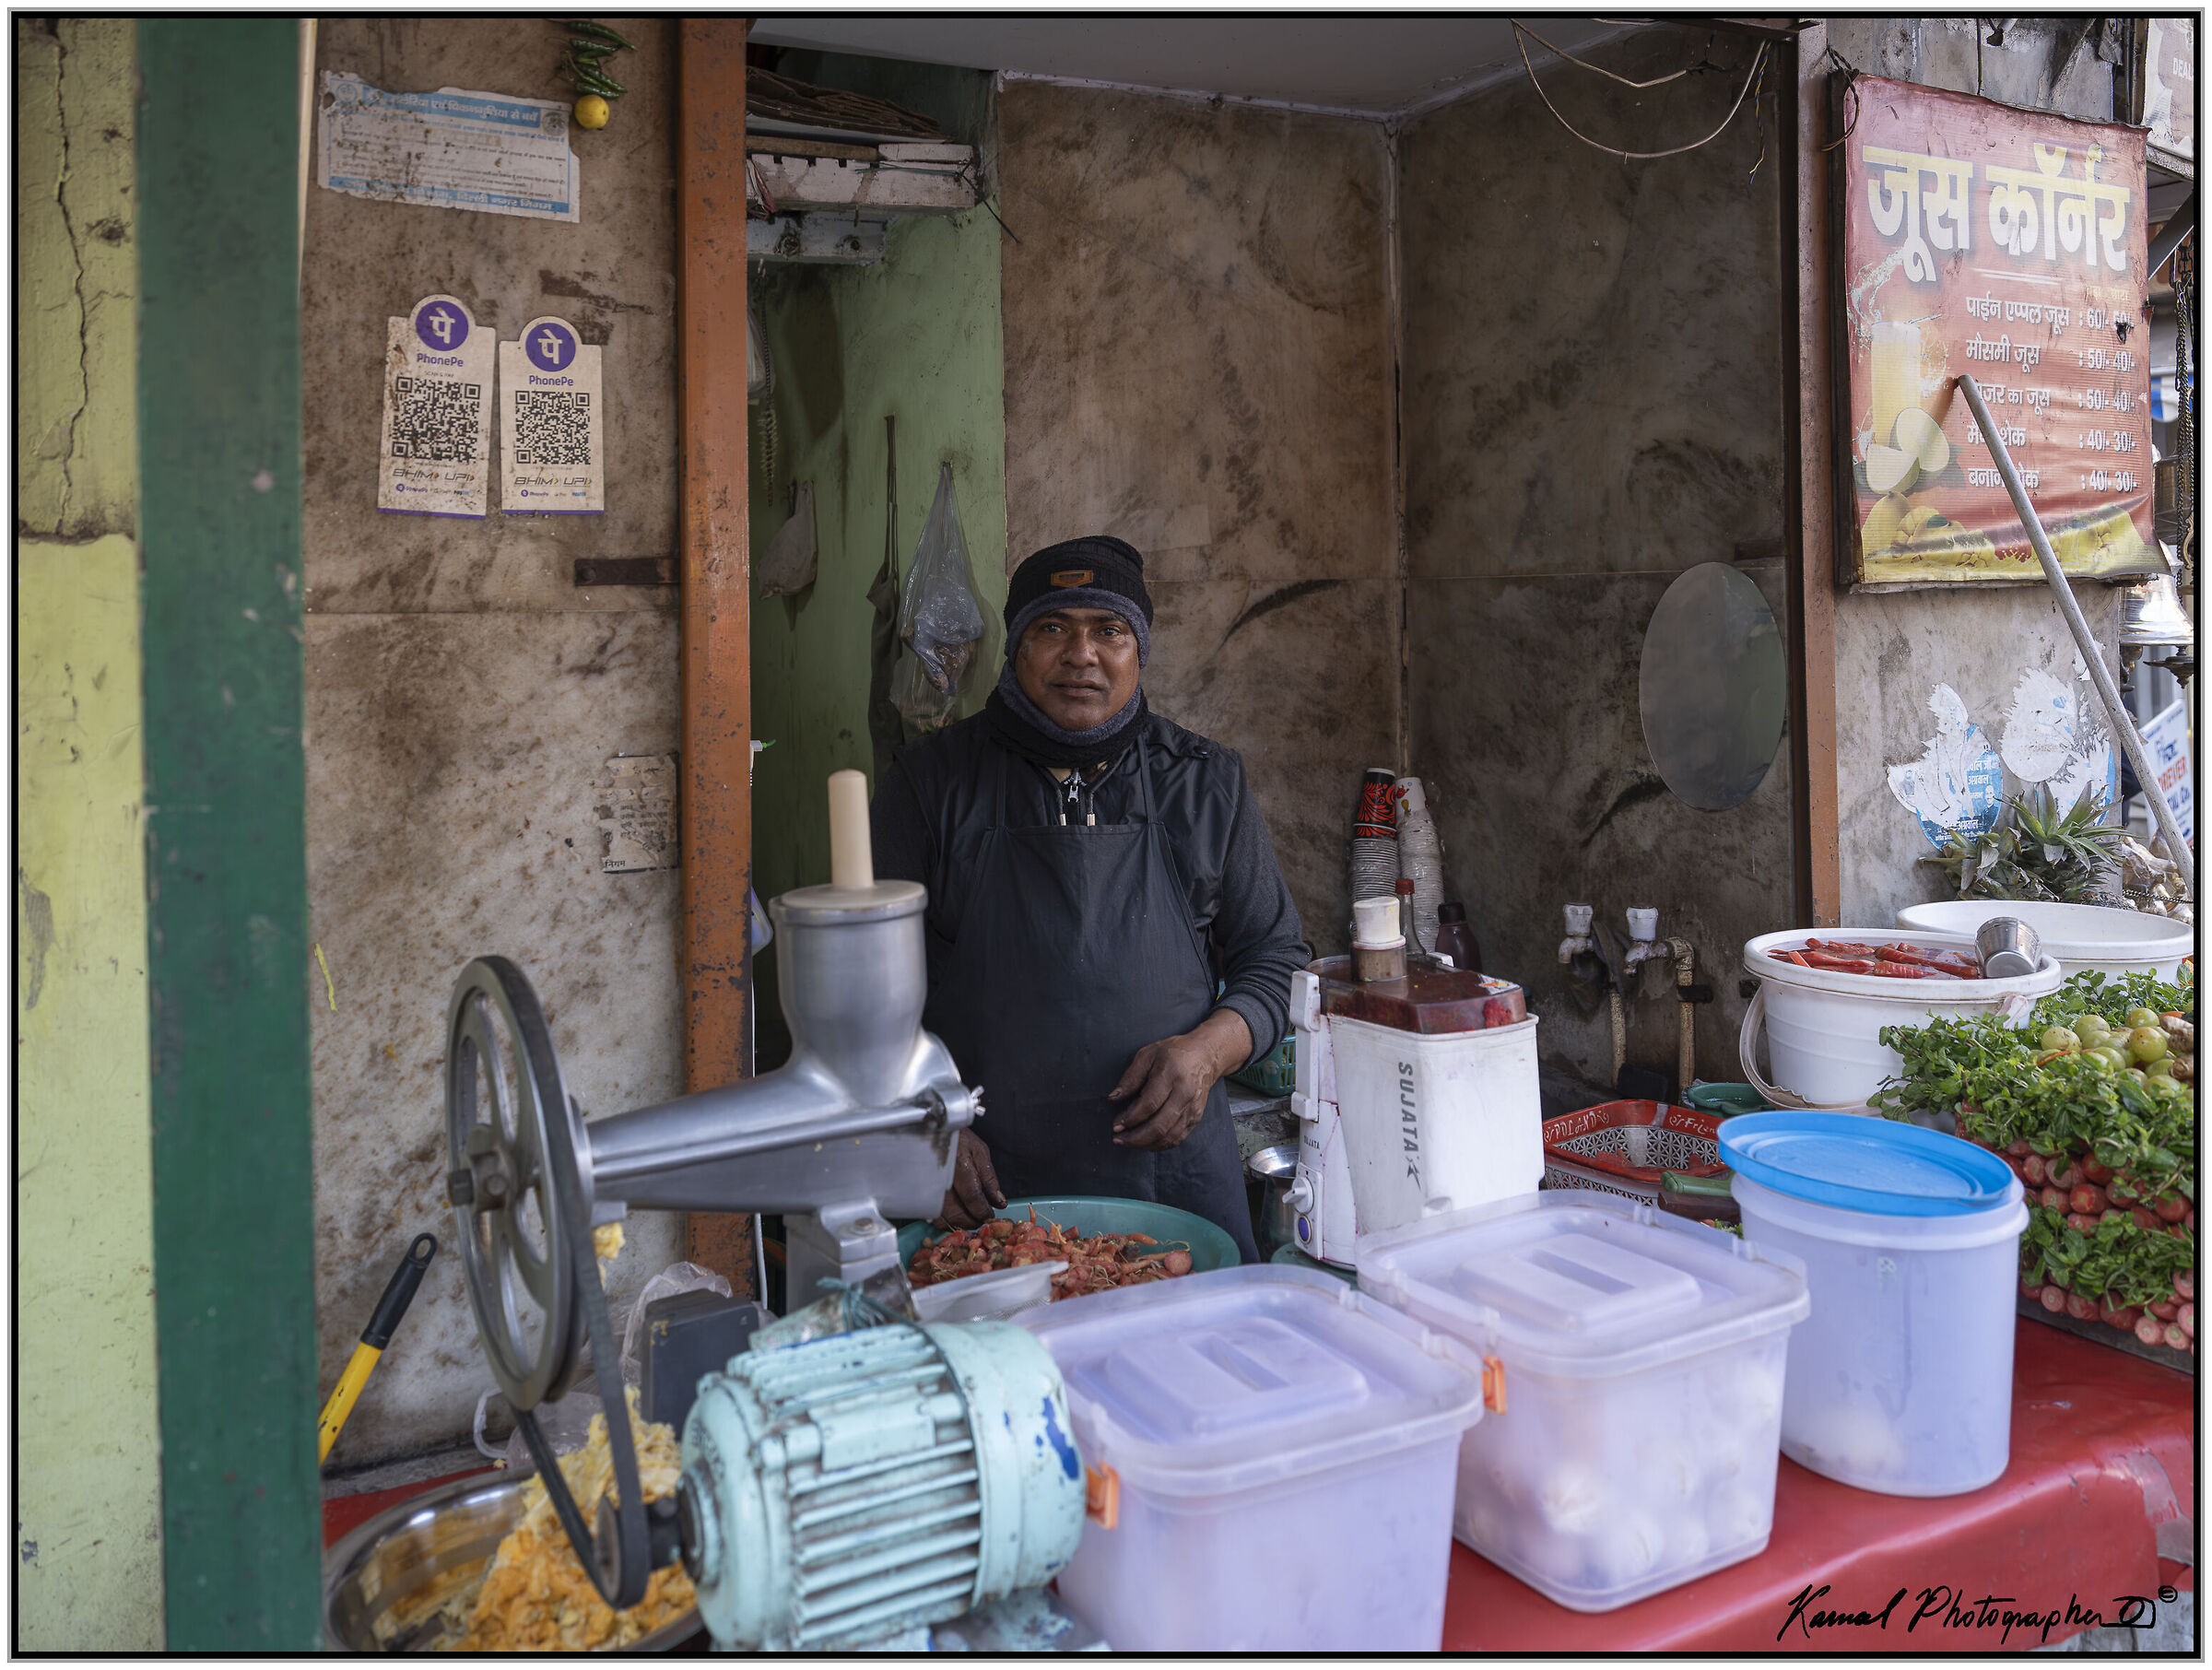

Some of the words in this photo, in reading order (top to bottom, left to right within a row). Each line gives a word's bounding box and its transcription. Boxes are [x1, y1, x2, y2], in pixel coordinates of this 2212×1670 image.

[2172, 57, 2194, 82] DEAL
[1863, 145, 1974, 282] जूस
[1986, 142, 2131, 272] कॉर्नर
[2006, 301, 2043, 324] एप्पल
[2045, 306, 2070, 335] जूस
[417, 353, 464, 368] PhonePe
[2014, 344, 2041, 373] जूस
[529, 375, 574, 386] PhonePe
[1977, 382, 2006, 404] ाजर
[2007, 389, 2024, 405] का
[2026, 388, 2052, 415] जूस
[393, 468, 434, 479] BHIM
[514, 476, 553, 486] BHIM
[1968, 468, 2006, 488] बनान
[1398, 1061, 1419, 1153] SUJATA
